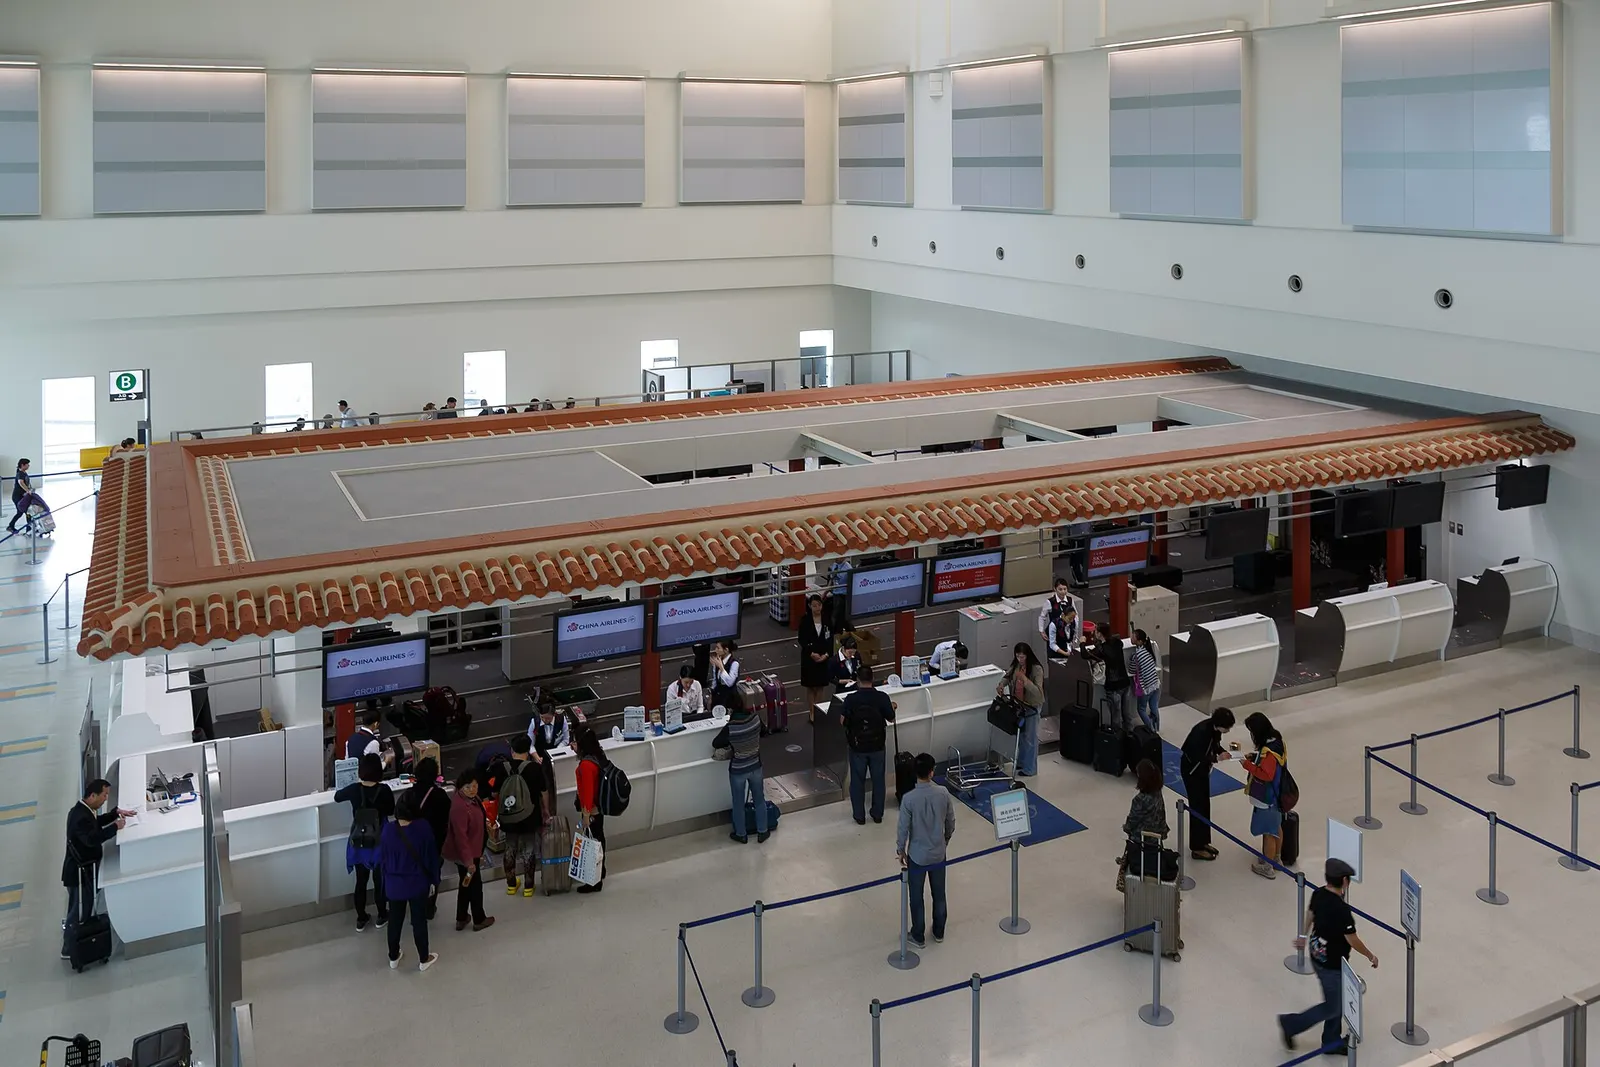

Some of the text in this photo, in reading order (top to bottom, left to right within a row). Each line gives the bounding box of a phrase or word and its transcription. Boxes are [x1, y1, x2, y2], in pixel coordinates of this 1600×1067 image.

[122, 376, 131, 388] B
[1092, 558, 1116, 566] PRIORITY
[886, 575, 908, 583] AIRLINES
[938, 582, 966, 590] PRIORITY
[697, 604, 722, 612] AIRLINES
[579, 618, 627, 630] CHINA AIRLINES
[578, 647, 612, 659] ECONOMY
[350, 652, 406, 667] CHINA AIRLINES
[354, 685, 383, 696] GROUP
